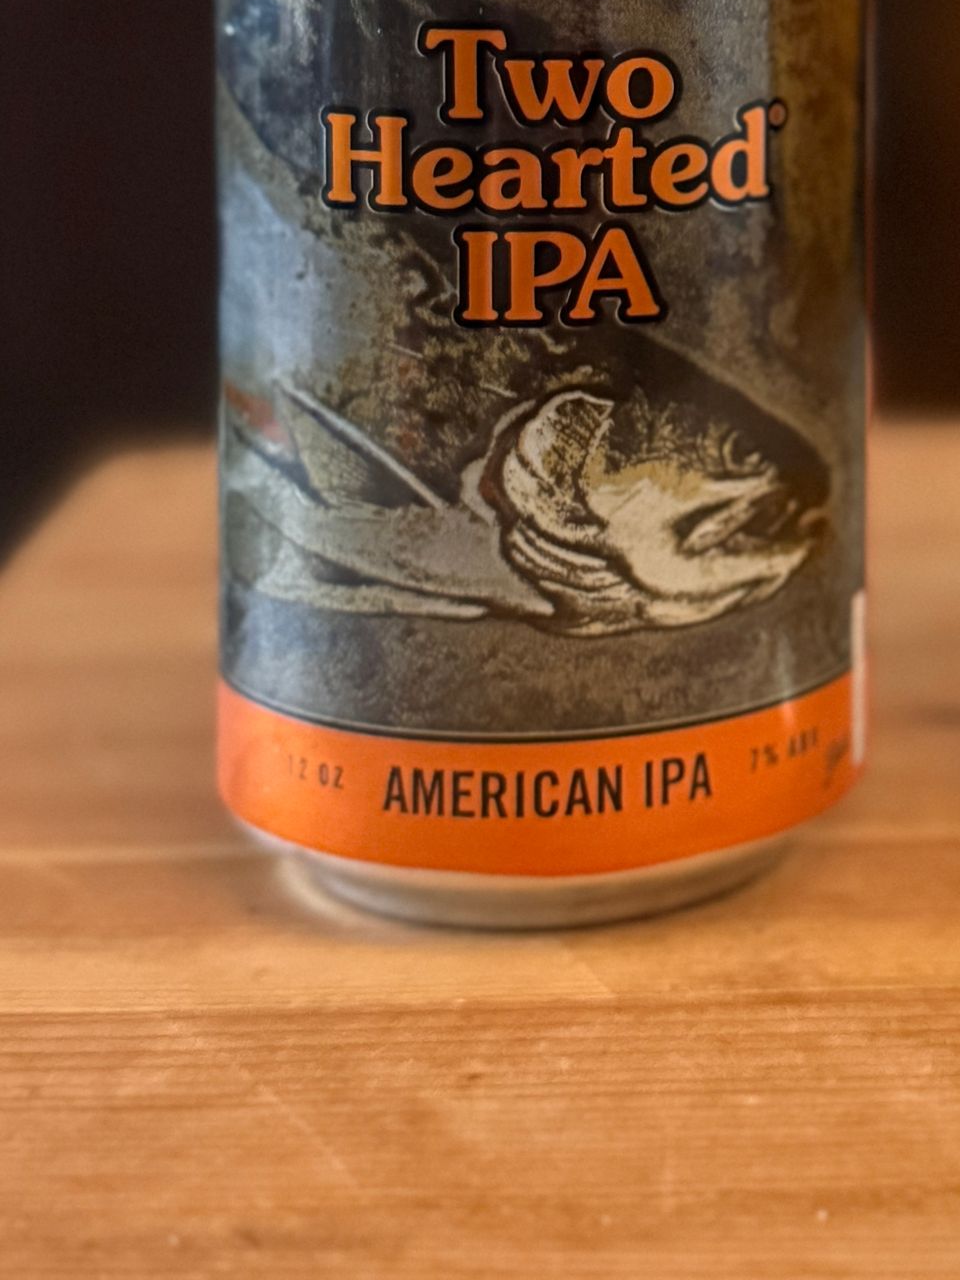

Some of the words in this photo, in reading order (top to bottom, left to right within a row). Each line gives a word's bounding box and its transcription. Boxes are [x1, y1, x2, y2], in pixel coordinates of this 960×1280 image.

[424, 28, 675, 122] Two
[325, 105, 770, 210] Hearted
[460, 227, 661, 322] IPA
[382, 765, 623, 819] AMERICAN
[643, 752, 713, 809] IPA
